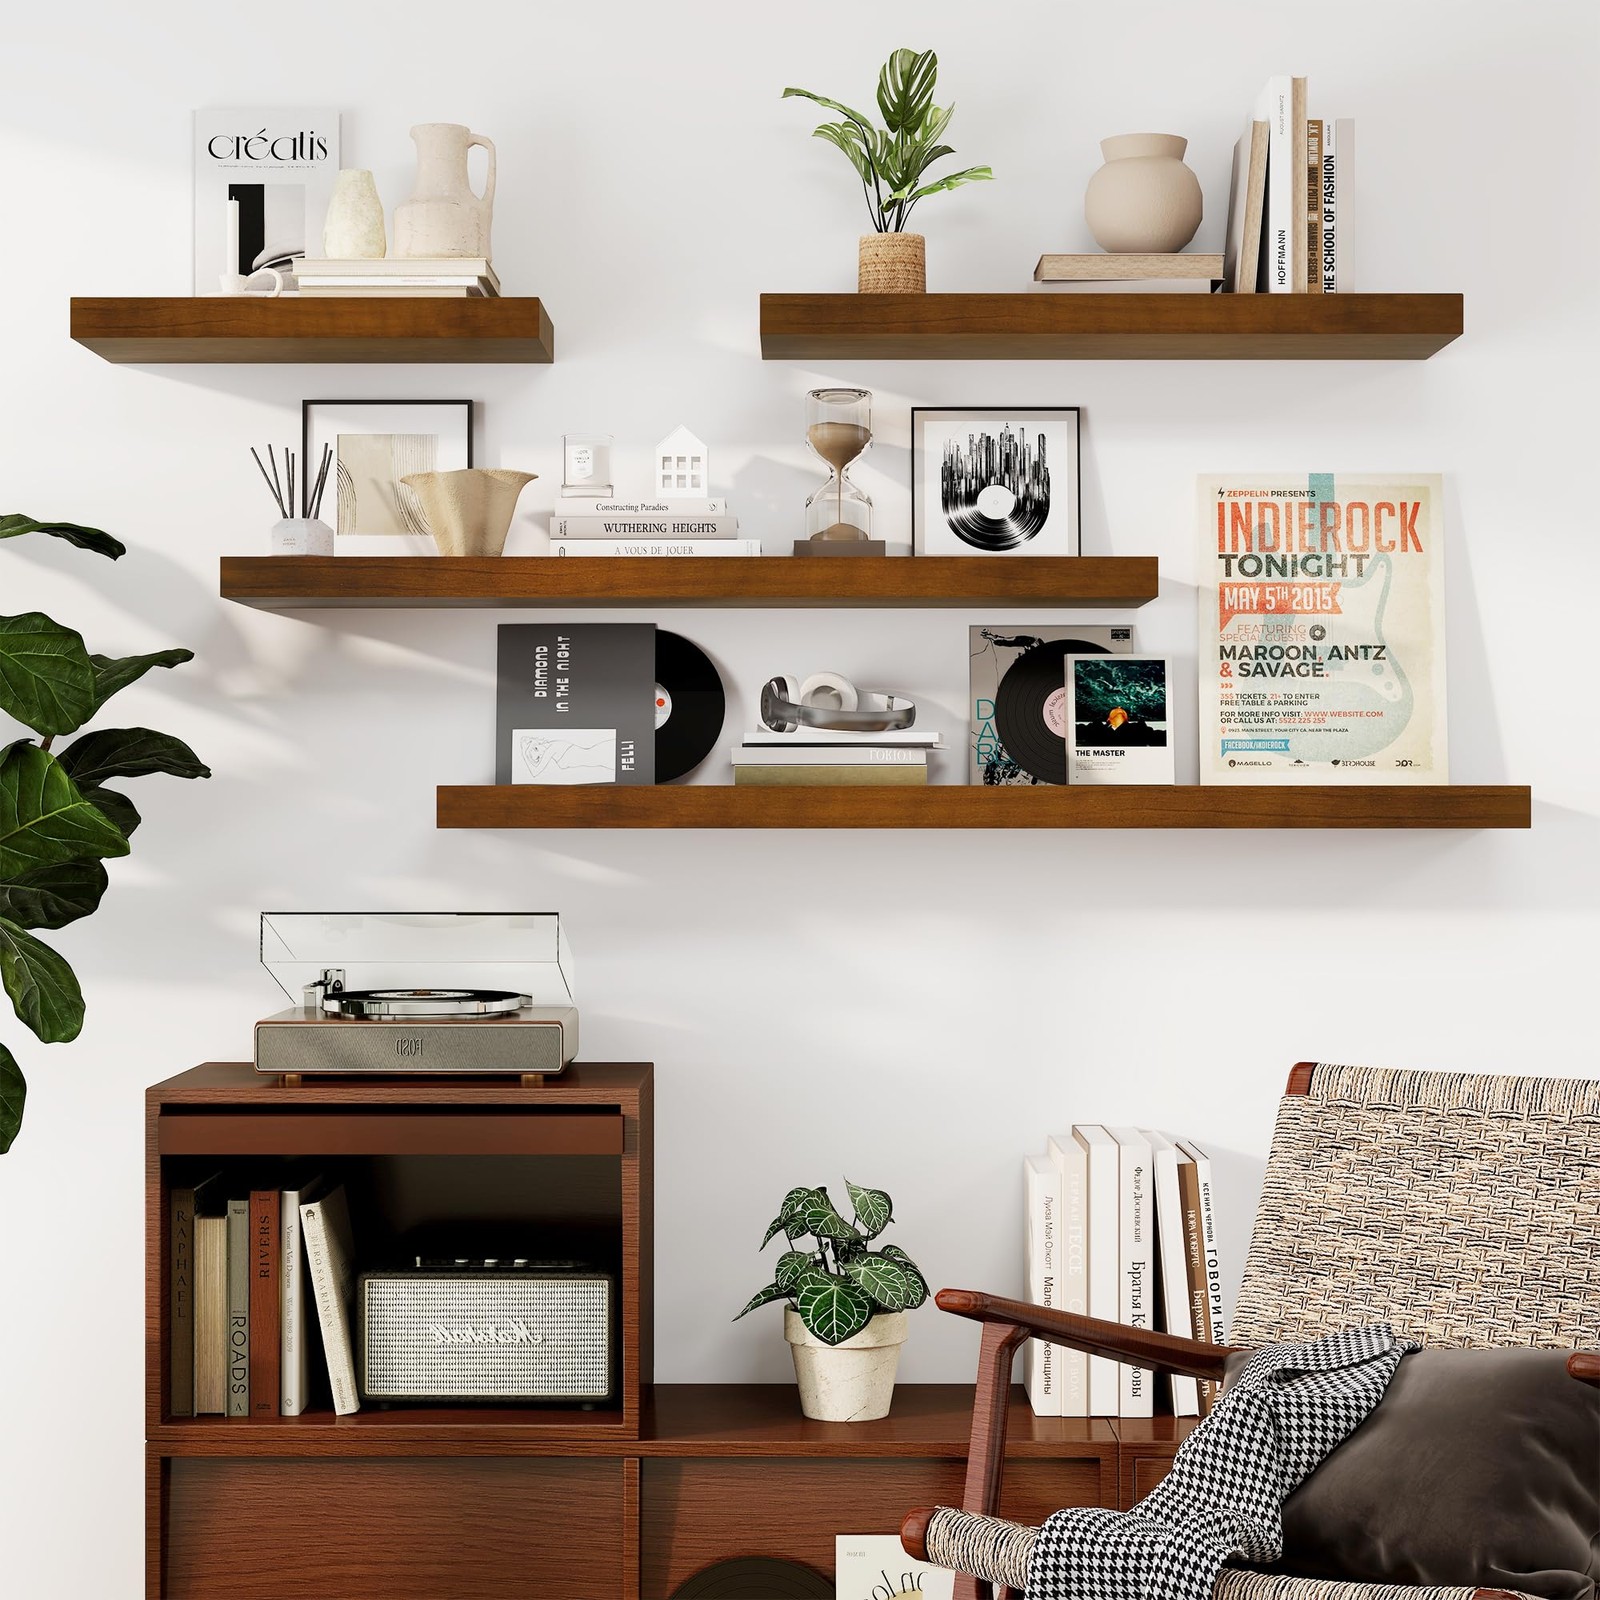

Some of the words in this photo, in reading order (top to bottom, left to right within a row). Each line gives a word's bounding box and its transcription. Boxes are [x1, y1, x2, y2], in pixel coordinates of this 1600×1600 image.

[1308, 137, 1318, 165] ROWLING
[1308, 166, 1318, 188] HARRY
[1324, 155, 1334, 204] FASHION
[1308, 188, 1318, 212] POTTER
[1324, 208, 1334, 223] OF
[1308, 222, 1318, 252] CHAMBER
[1324, 226, 1334, 272] SCHOOL
[1278, 230, 1286, 285] HOFFMANN
[1308, 258, 1318, 284] SECRETS
[596, 503, 638, 512] Constructing
[640, 503, 668, 512] Paradies
[604, 523, 667, 533] WUTHERING
[672, 523, 716, 533] HEIGHTS
[1218, 502, 1424, 552] INDIEROCK
[615, 546, 621, 555] A
[624, 546, 648, 555] VOUS
[651, 546, 663, 555] DE
[666, 546, 694, 557] JOUER
[1218, 554, 1370, 578] TONIGHT
[1224, 587, 1260, 611] MAY
[1265, 586, 1288, 611] 5TH
[1292, 587, 1332, 611] 2015
[1220, 634, 1264, 642] SPECIAL
[1265, 634, 1306, 642] GUESTS
[1237, 625, 1306, 634] FEATURING
[557, 636, 570, 670] NIGHT
[1220, 645, 1323, 662] MAROON,
[1328, 645, 1386, 660] ANTZ
[534, 646, 548, 698] DIAMOND
[1220, 663, 1233, 678] &
[1238, 662, 1330, 678] SAVAGE.
[556, 678, 569, 697] THE
[556, 702, 569, 712] IN
[621, 741, 635, 771] FELLI
[1224, 742, 1286, 750] FACEBOOK/INDIEROCK
[1045, 1196, 1053, 1220] Луиза
[1203, 1182, 1211, 1213] КСЕНИЯ
[1044, 1222, 1053, 1240] Мэй
[1187, 1210, 1196, 1231] НОРА
[260, 1215, 270, 1278] RIVERS
[286, 1225, 294, 1249] Vincent
[1189, 1232, 1200, 1268] РОБЕРТС
[177, 1210, 187, 1318] RAPHAEL
[286, 1251, 294, 1263] Van
[1044, 1241, 1053, 1270] Олкотт
[1069, 1226, 1082, 1276] ГЕССЕ
[285, 1265, 294, 1288] Duysen
[1127, 1261, 1146, 1309] Братья
[1207, 1249, 1224, 1314] ГОВОРИ
[316, 1269, 332, 1328] SAARINEN
[1044, 1277, 1053, 1307] Мале
[286, 1297, 294, 1316] Works
[1193, 1289, 1206, 1342] Бархатн
[286, 1318, 294, 1353] 1989-2009
[1213, 1315, 1225, 1346] КАК
[232, 1316, 246, 1394] ROADS
[1198, 1378, 1210, 1397] рть
